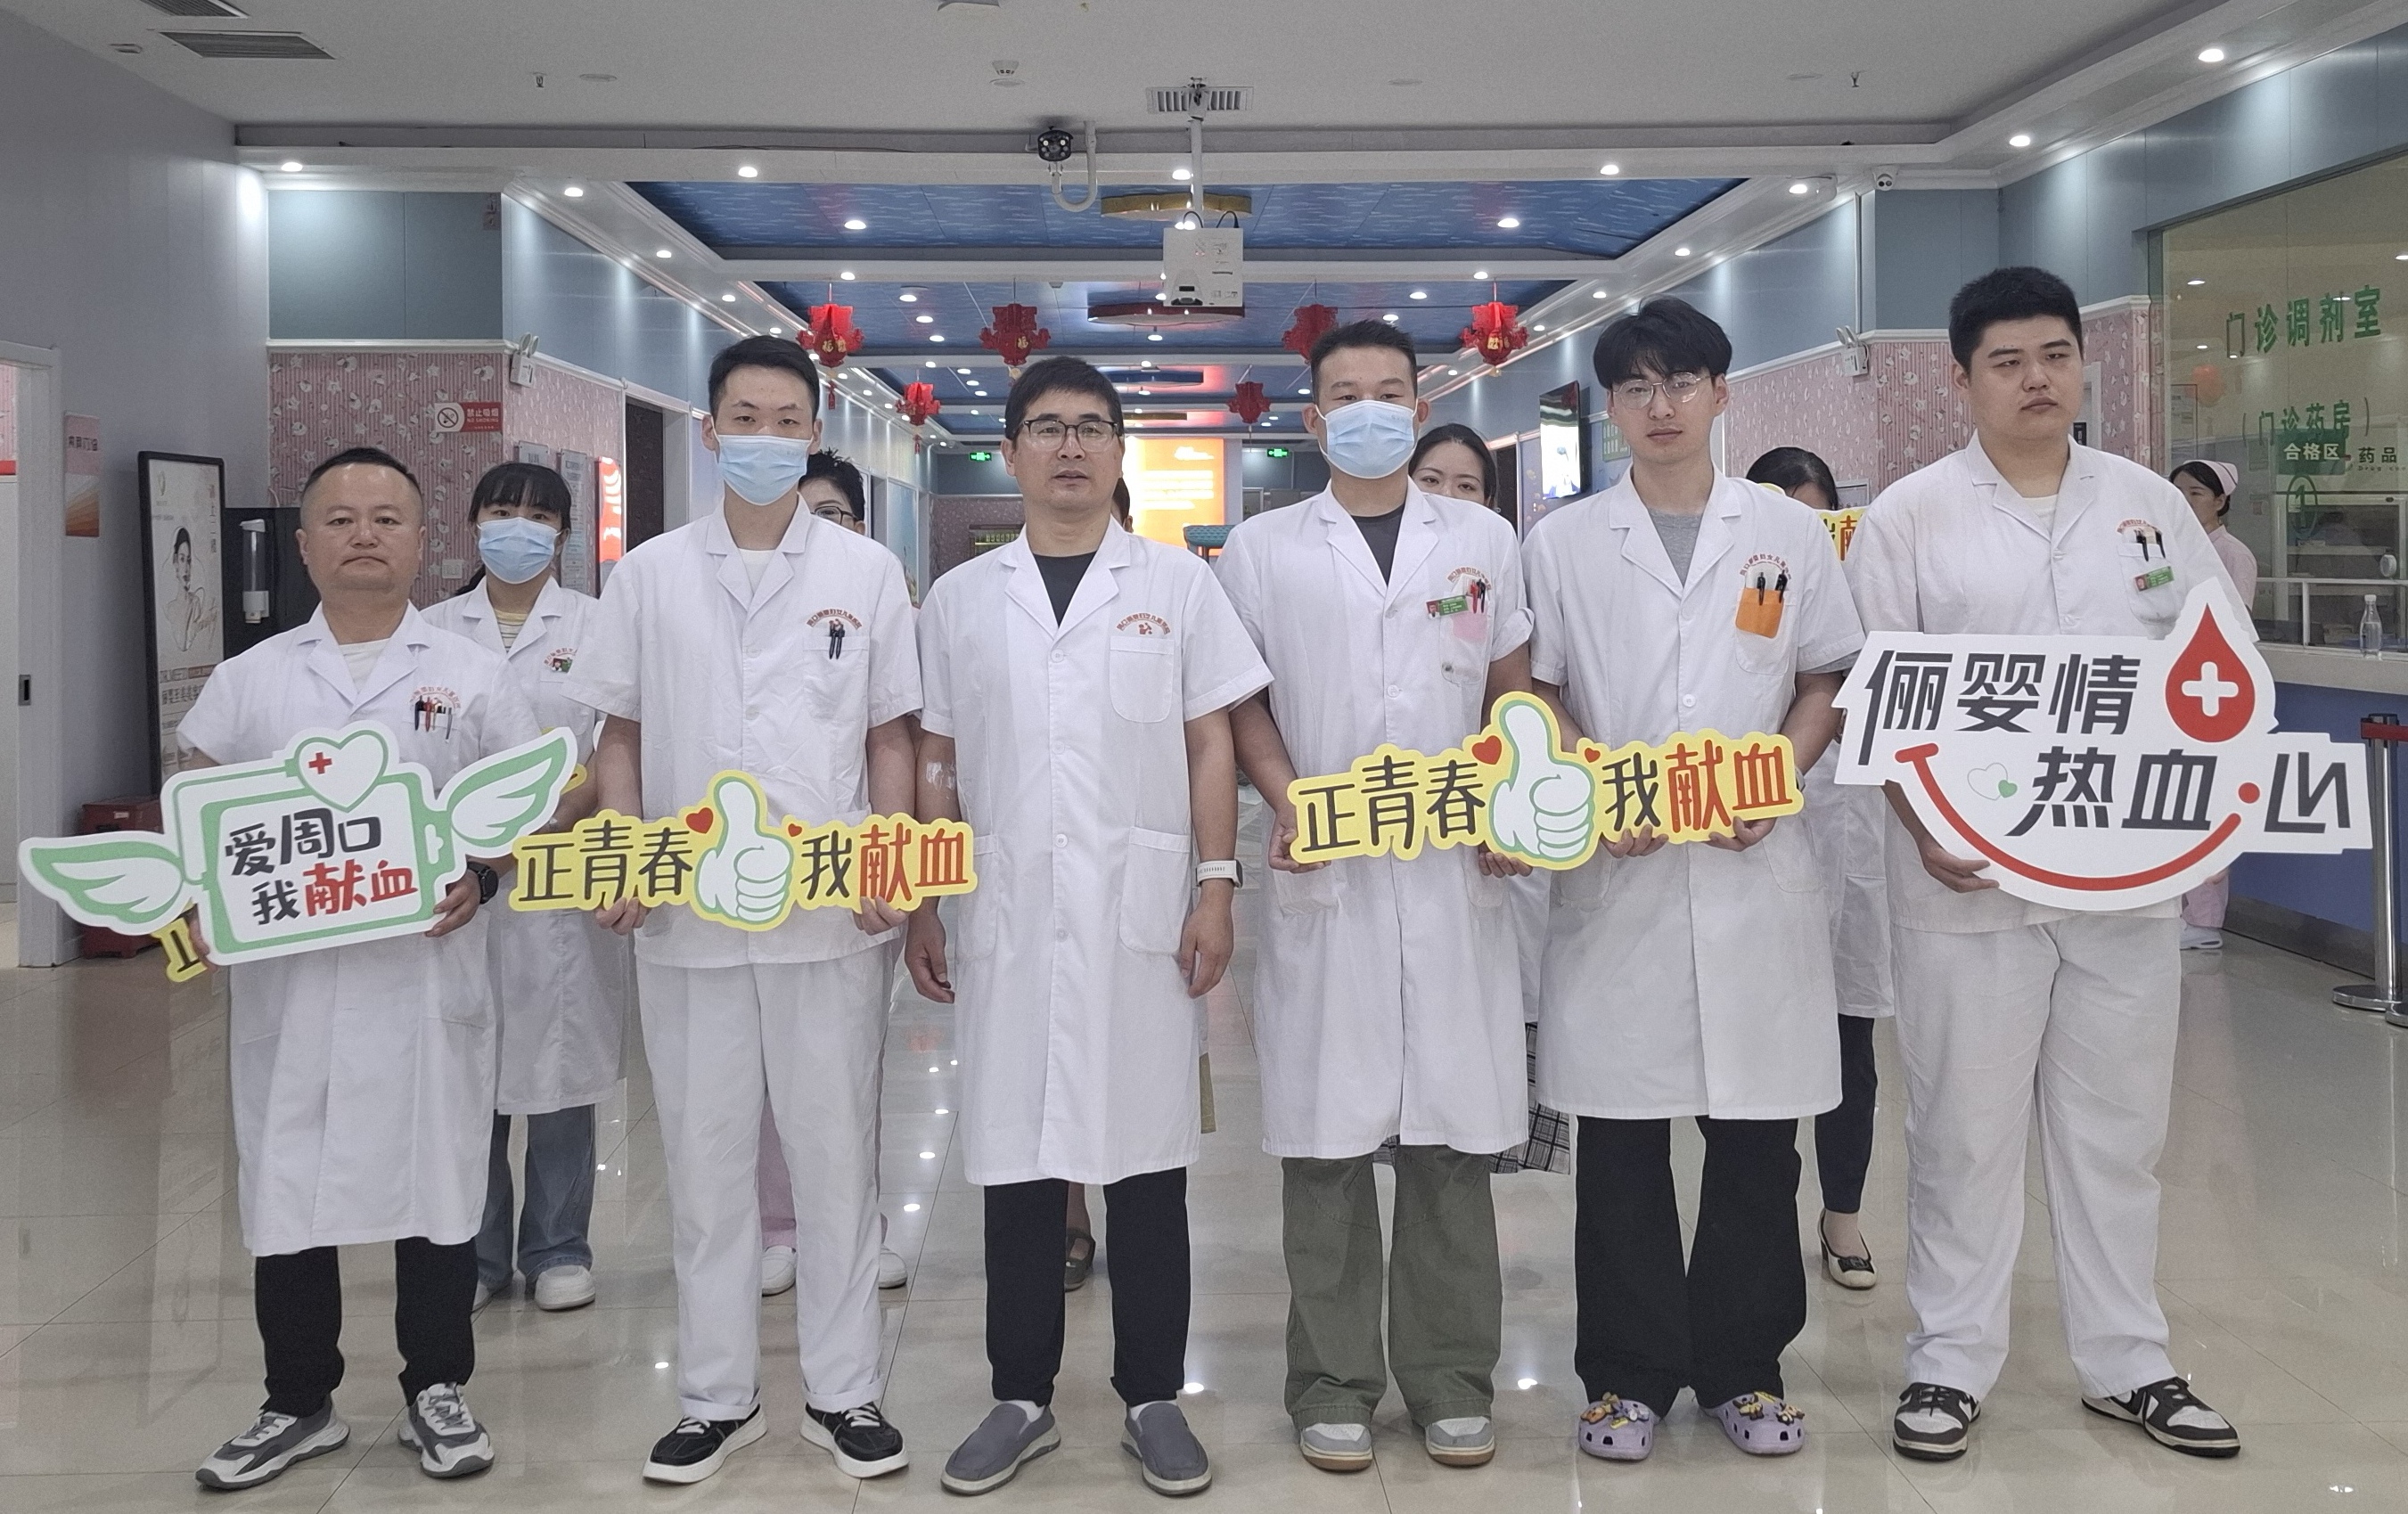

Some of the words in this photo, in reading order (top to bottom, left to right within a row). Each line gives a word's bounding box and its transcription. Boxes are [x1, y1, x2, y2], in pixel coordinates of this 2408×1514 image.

[2225, 284, 2381, 358] 门诊调剂室
[2283, 443, 2340, 461] 合格区
[2358, 446, 2397, 463] 药品
[1857, 650, 2141, 766] 俪婴情
[1298, 754, 1487, 853] 正青春
[1602, 739, 1793, 833] 我献血
[225, 807, 381, 877] 爱周口
[519, 819, 693, 906] 正青春
[800, 822, 969, 904] 我献血
[251, 860, 419, 926] 我献血
